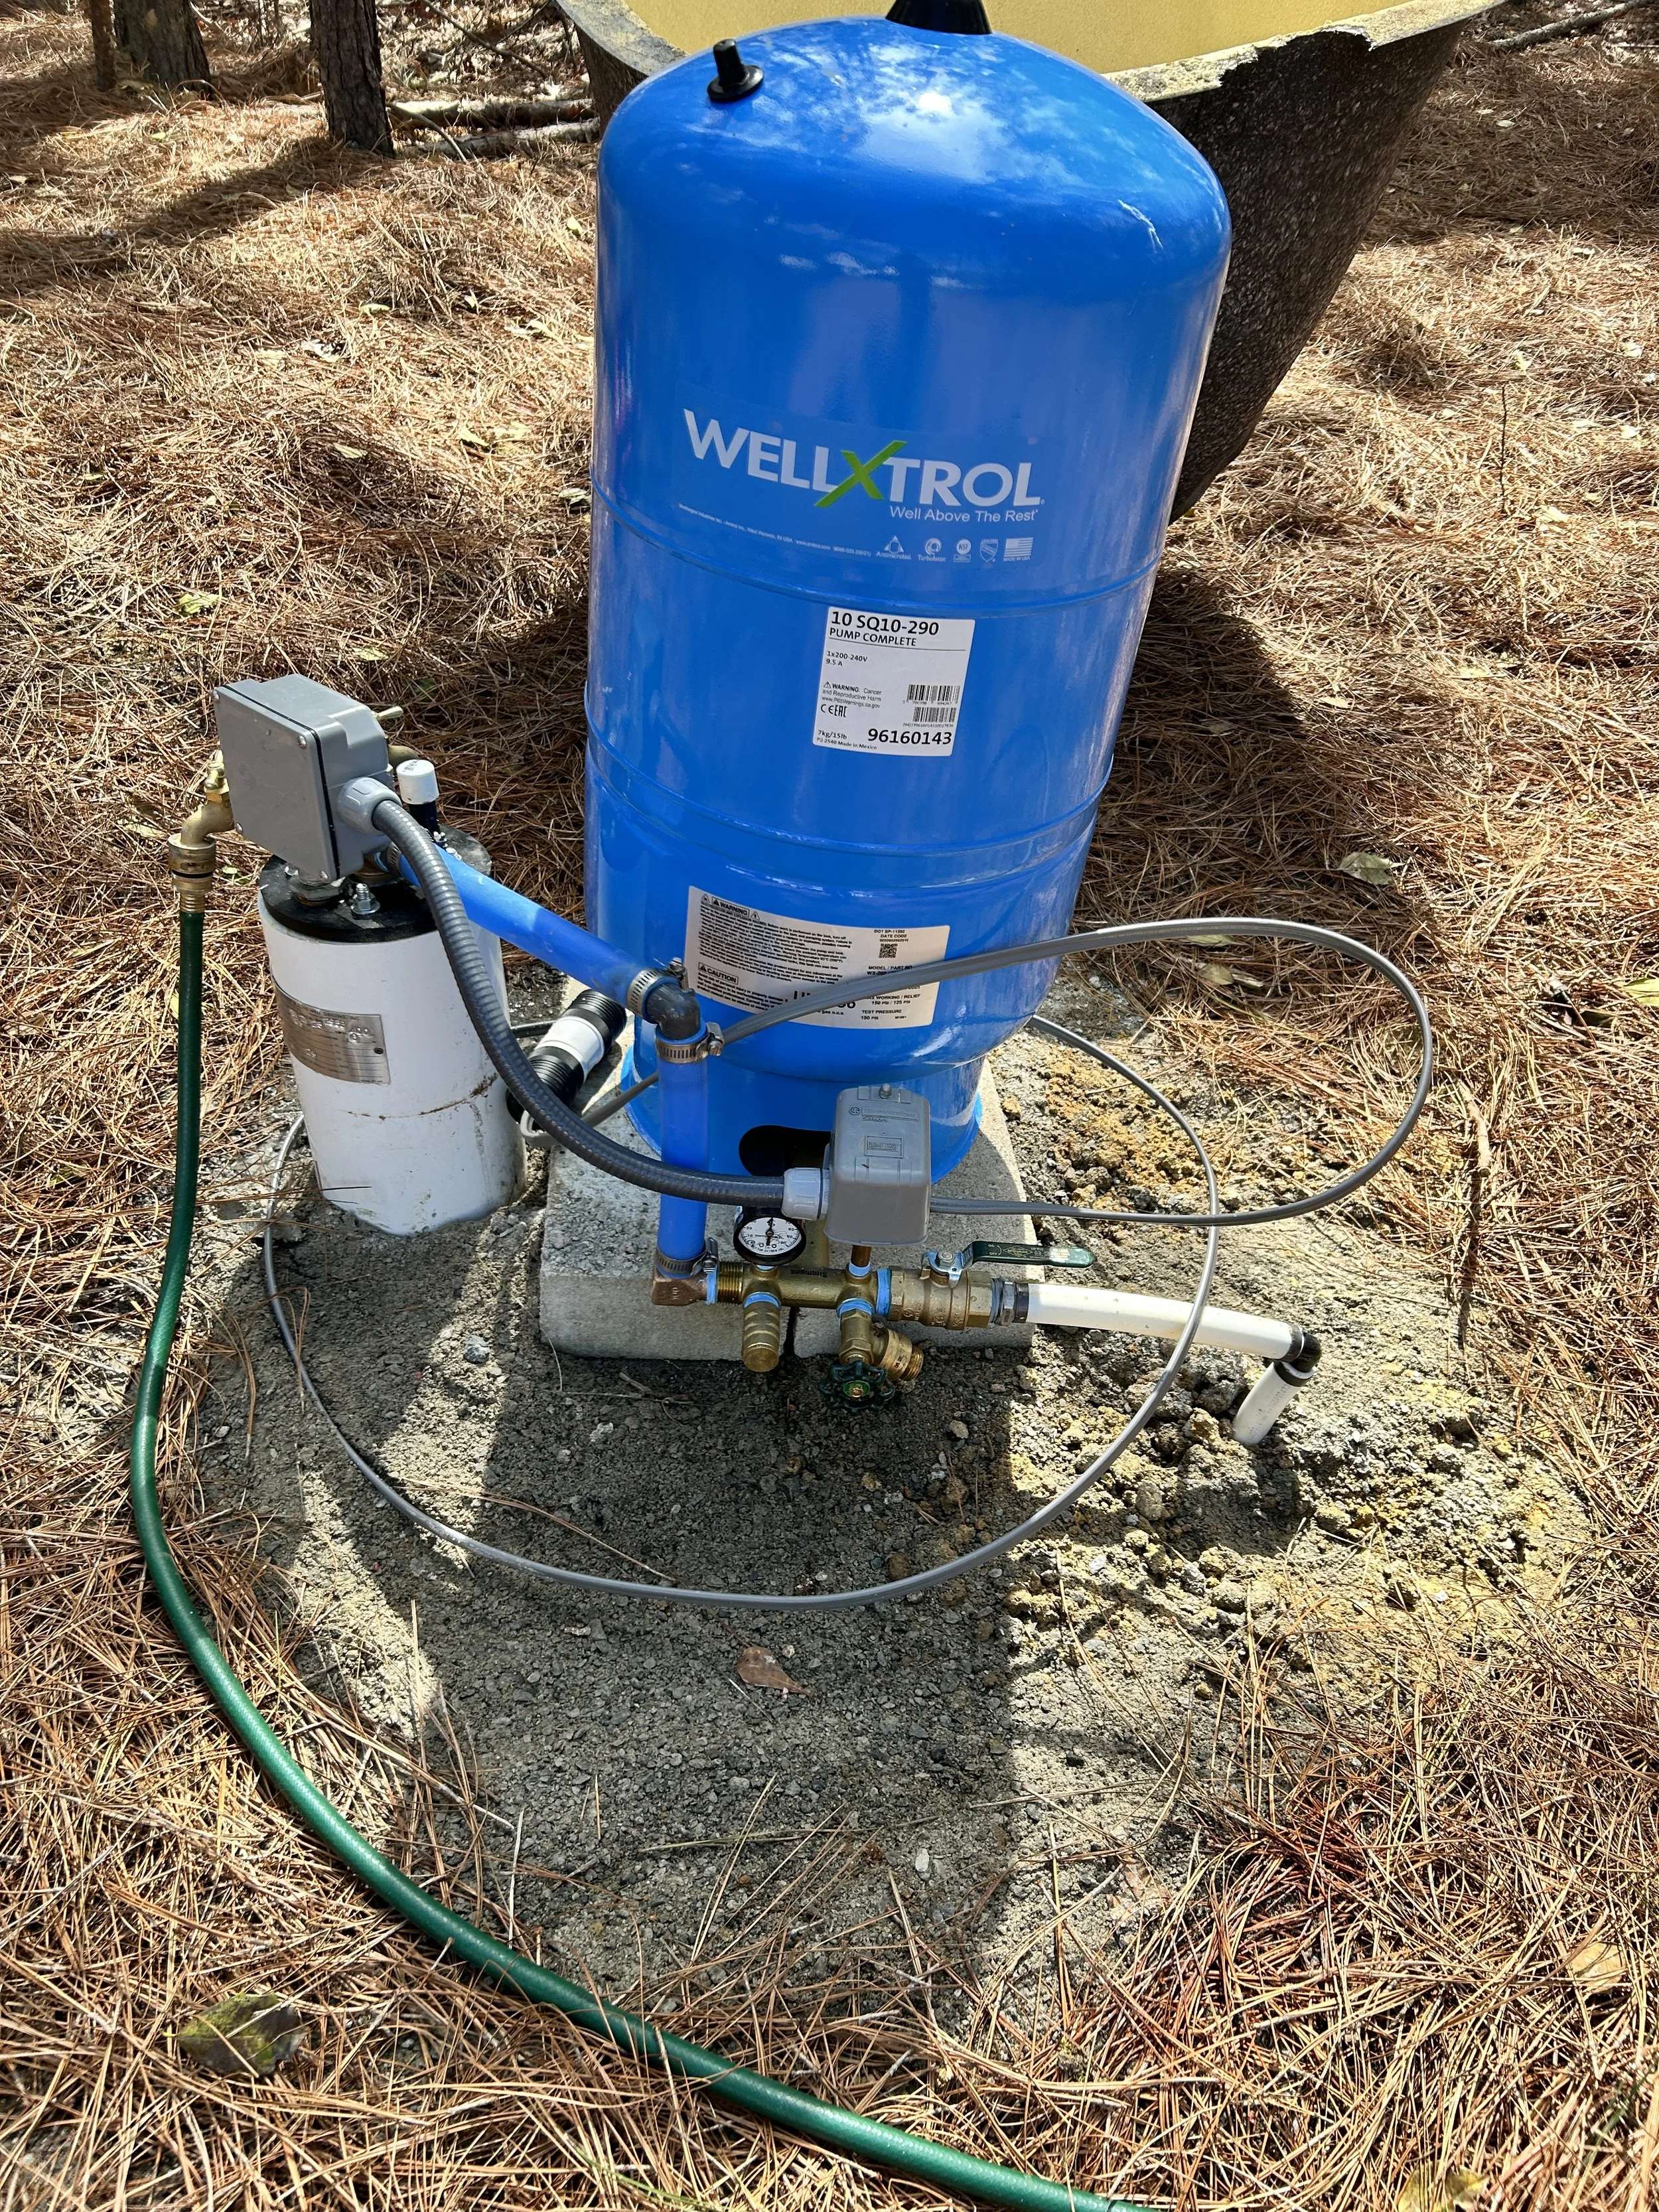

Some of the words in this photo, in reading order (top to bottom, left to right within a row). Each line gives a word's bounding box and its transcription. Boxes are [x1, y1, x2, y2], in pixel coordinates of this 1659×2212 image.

[890, 506, 921, 520] Well
[924, 508, 971, 522] Above
[975, 510, 1001, 522] The
[831, 611, 853, 627] 10
[857, 615, 939, 635] SQ10-290
[830, 628, 861, 640] PUMP
[863, 632, 917, 646] COMPLETE
[827, 650, 868, 662] 1x200-240V
[832, 683, 861, 693] WARNING:
[833, 690, 866, 700] Reproductive
[822, 696, 881, 709] www.P65Warnings.ca.gov
[818, 729, 847, 740] 7kg/15lb
[867, 728, 952, 745] 96160143
[720, 901, 748, 916] WARNING
[707, 968, 737, 984] CAUTION
[791, 1269, 828, 1278] Simmons
